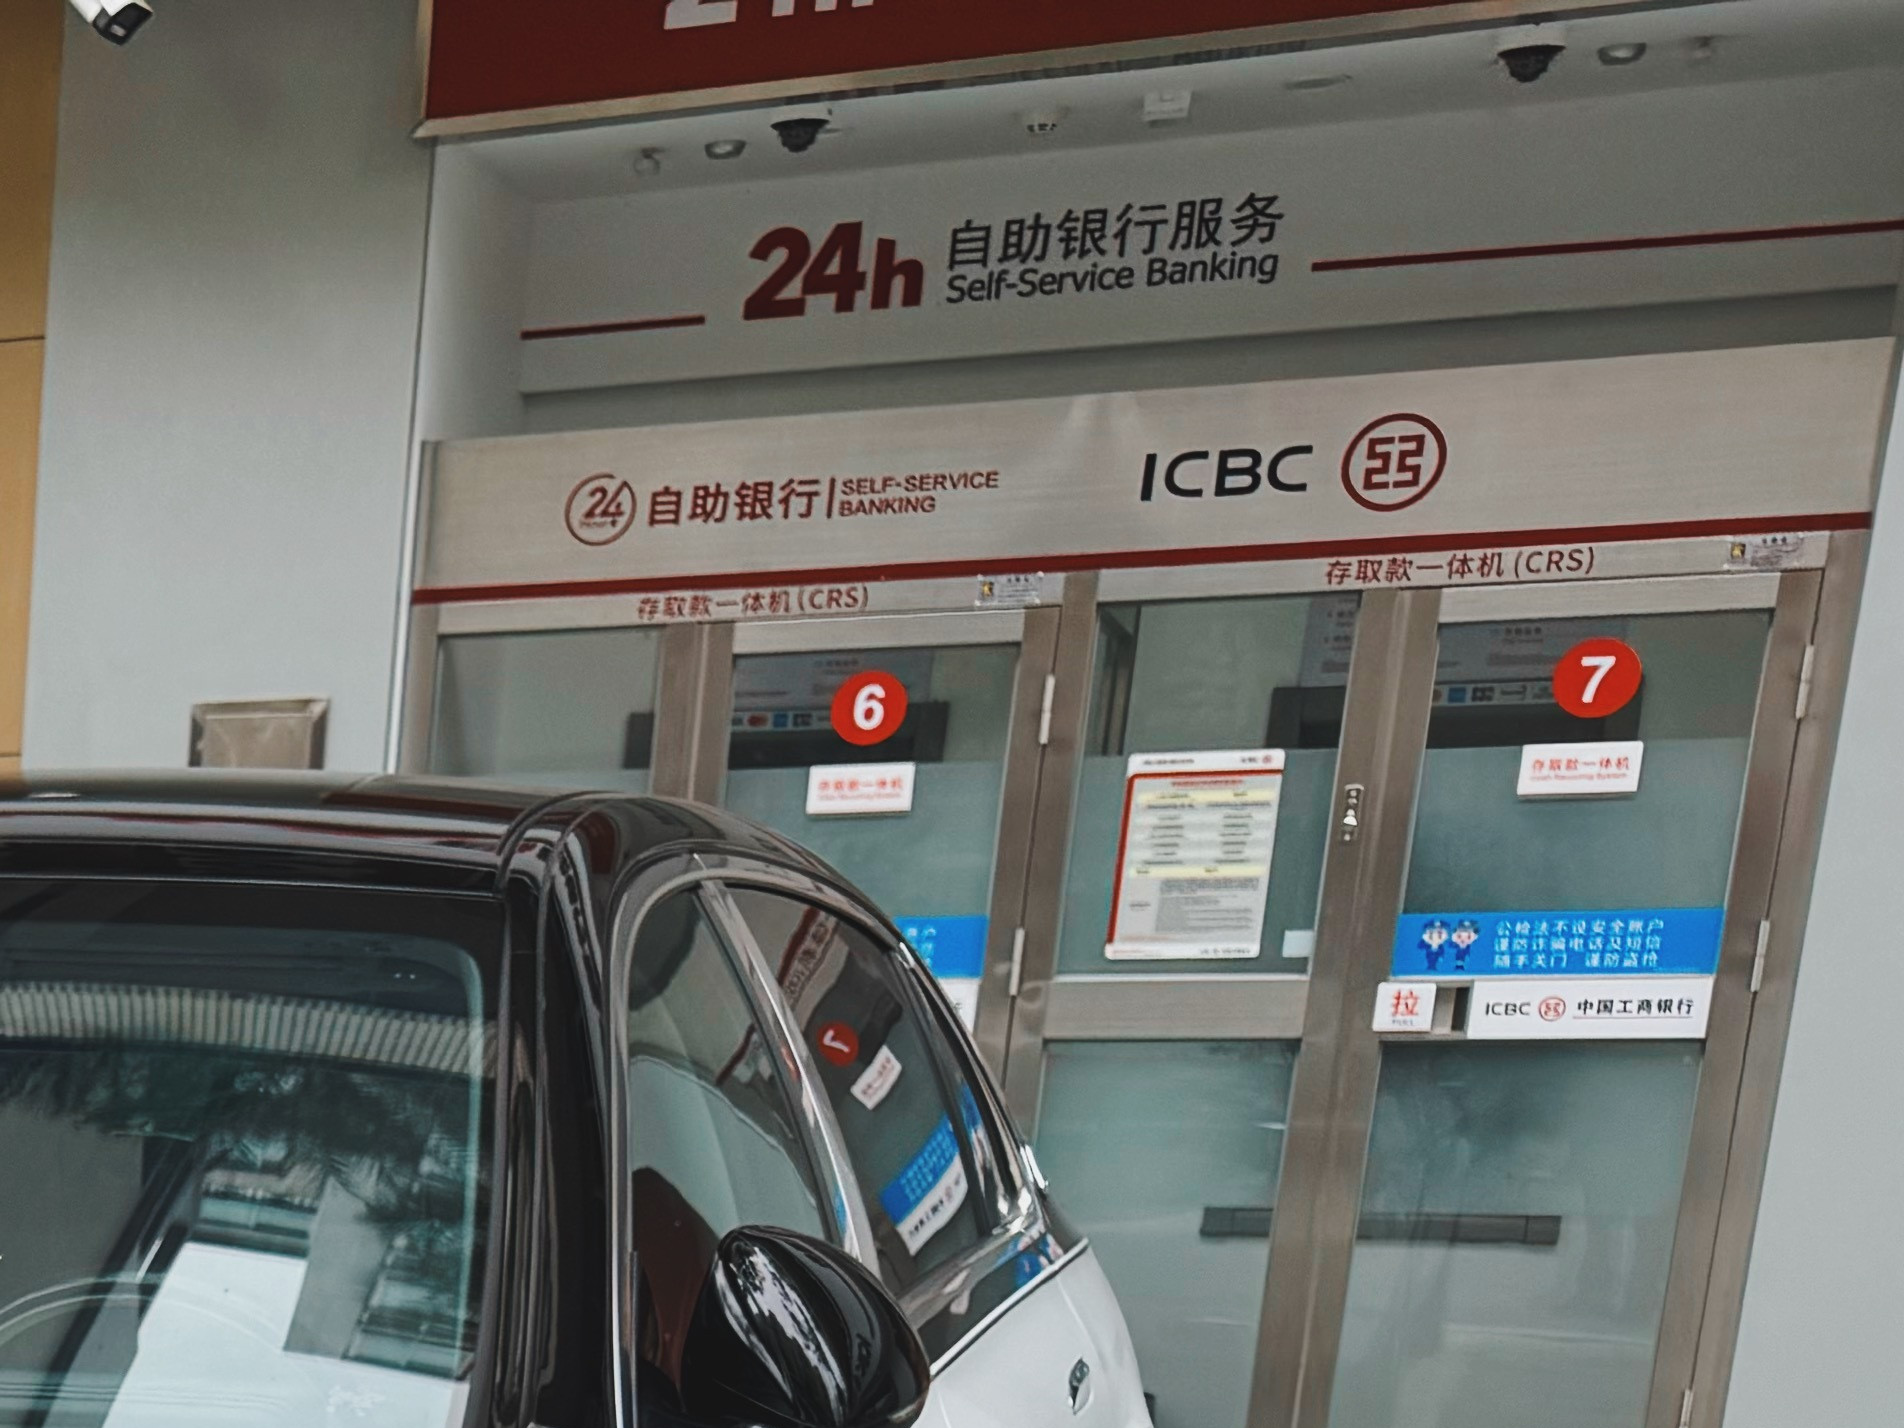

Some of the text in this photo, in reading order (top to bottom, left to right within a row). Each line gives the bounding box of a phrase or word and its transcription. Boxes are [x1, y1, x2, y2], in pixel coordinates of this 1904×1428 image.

[742, 192, 1285, 321] 24h 自助银行服务
[945, 250, 1280, 304] Self-Service Banking
[840, 470, 1001, 497] SELF-SERVICE
[1140, 444, 1314, 502] ICBC
[648, 477, 822, 528] 自助银行
[838, 495, 937, 518] BANKING
[1579, 655, 1617, 704] 7
[852, 683, 887, 731] 6
[1391, 988, 1420, 1017] 拉
[1485, 1001, 1532, 1016] ICBC
[1577, 997, 1695, 1016] 中国工商银行
